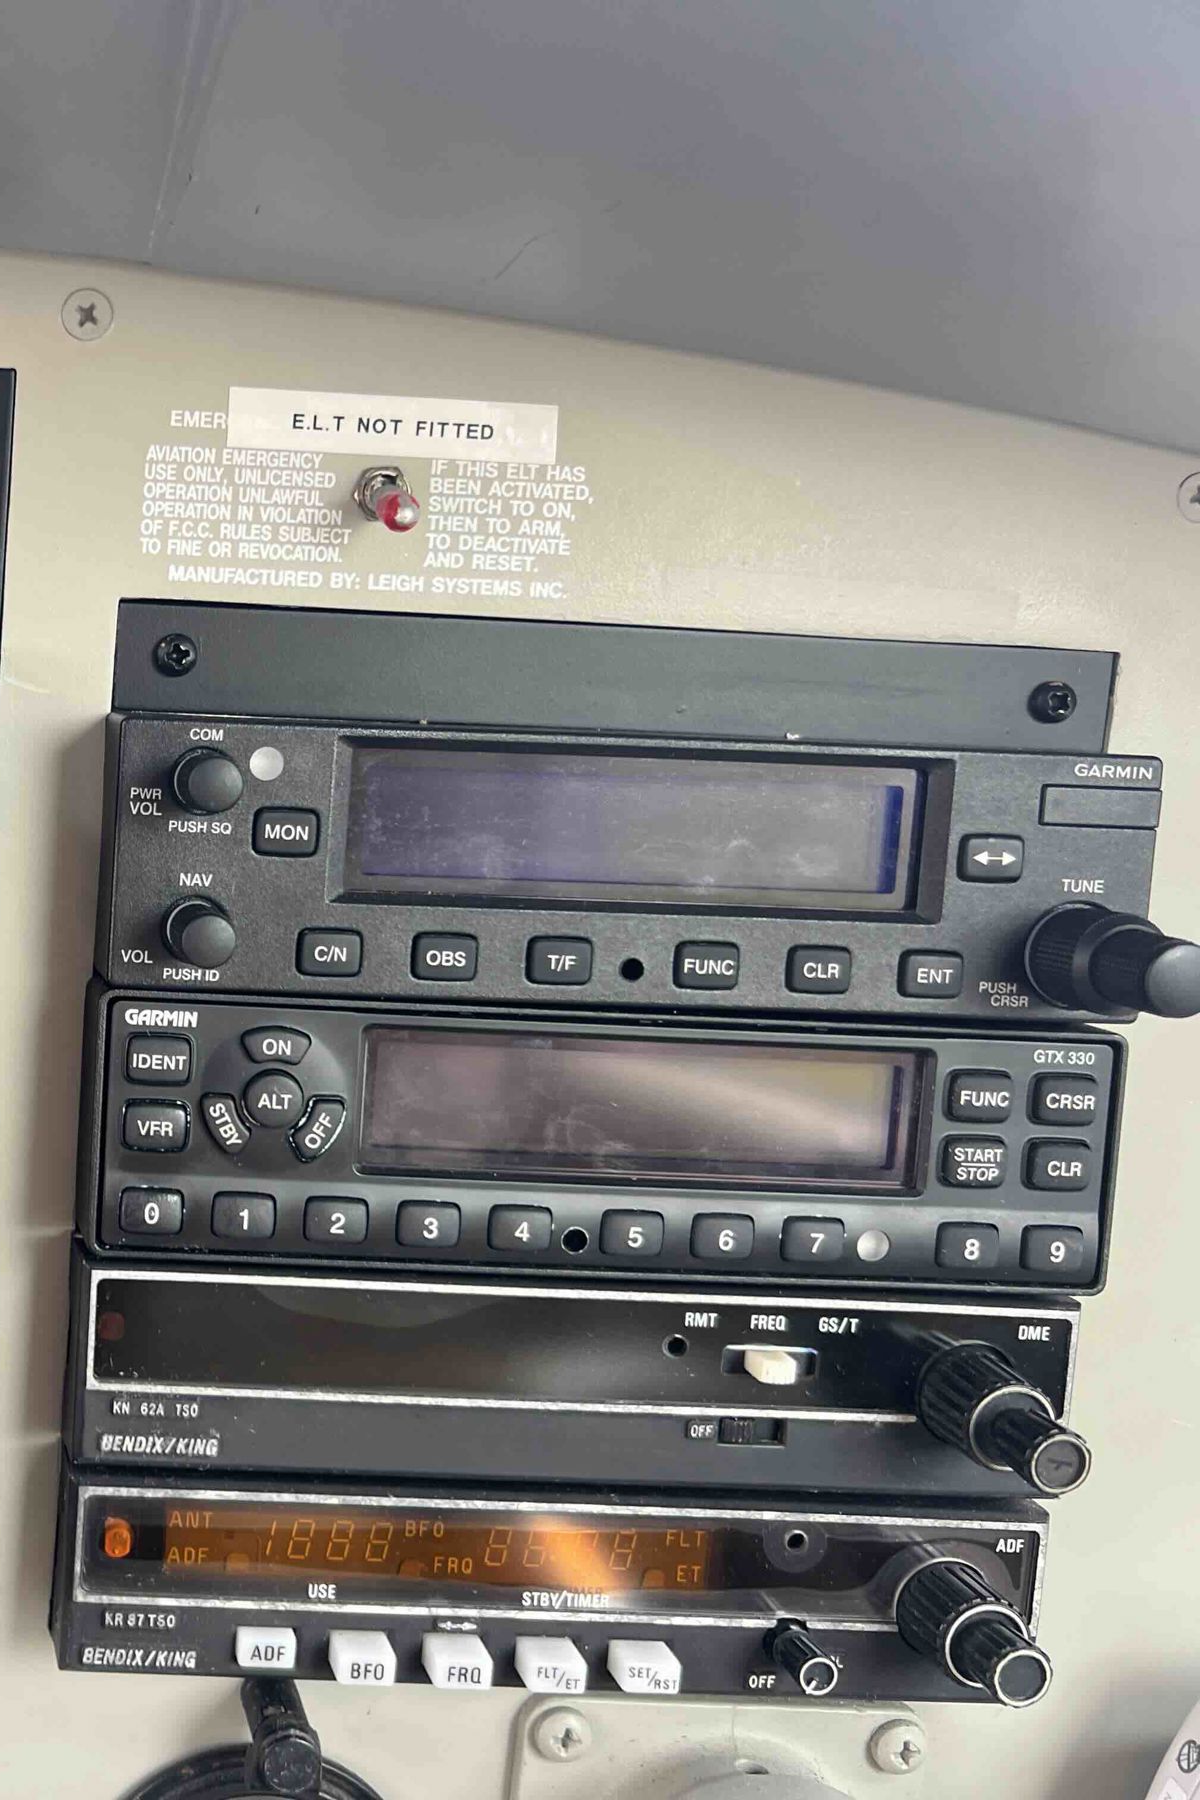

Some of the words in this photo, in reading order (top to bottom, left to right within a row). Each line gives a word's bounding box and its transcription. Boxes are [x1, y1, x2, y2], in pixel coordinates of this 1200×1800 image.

[293, 414, 345, 432] E.L.T
[358, 418, 401, 435] NOT
[416, 421, 494, 440] FITTED
[147, 445, 216, 463] AVIATION
[222, 449, 323, 468] EMERGENCY
[145, 465, 179, 480] USE
[184, 466, 227, 484] ONLY,
[234, 470, 336, 488] UNLICENSED
[432, 460, 448, 475] IF
[453, 461, 498, 477] THIS
[506, 464, 540, 479] ELT
[547, 466, 585, 482] HAS
[144, 483, 232, 501] OPERATION
[239, 487, 324, 506] UNLAWFUL
[430, 479, 483, 496] BEEN
[490, 481, 593, 503] ACTIVATED,
[143, 502, 231, 519] OPERATION
[237, 506, 254, 520] IN
[260, 507, 341, 525] VIOLATION
[429, 497, 500, 515] SWITCH
[512, 500, 534, 516] TO
[543, 502, 576, 522] ON,
[141, 520, 162, 535] OF
[168, 522, 214, 538] F.C.C.
[221, 523, 272, 541] RULES
[279, 527, 351, 545] SUBJECT
[429, 516, 478, 532] THEN
[486, 518, 511, 534] TO
[518, 520, 565, 538] ARM,
[141, 538, 161, 554] TO
[168, 540, 203, 556] FINE
[209, 542, 232, 557] OR
[238, 543, 343, 562] REVOCATION.
[427, 534, 449, 550] TO
[459, 536, 570, 555] DEACTIVATE
[424, 552, 466, 569] AND
[473, 554, 538, 572] RESET.
[168, 565, 322, 588] MANUFACTURED
[331, 572, 360, 589] BY:
[368, 574, 424, 593] LEIGH
[432, 577, 522, 597] SYSTEMS
[531, 581, 566, 598] INC.
[190, 729, 223, 741] COM
[1074, 764, 1153, 779] GARMIN
[131, 788, 162, 799] PWR
[130, 802, 162, 816] VOL
[169, 821, 207, 835] PUSH
[212, 822, 231, 836] SQ
[265, 825, 308, 841] MON
[179, 873, 212, 887] NAV
[1062, 879, 1104, 894] TUNE
[121, 950, 152, 965] VOL
[314, 946, 347, 963] C/N
[426, 950, 466, 967] OBS
[548, 955, 575, 971] T/F
[684, 959, 734, 975] FUNC
[163, 968, 200, 980] PUSH
[207, 970, 219, 981] ID
[804, 963, 839, 980] CLR
[918, 967, 952, 983] ENT
[979, 982, 1016, 995] PUSH
[991, 995, 1028, 1007] CRSR
[125, 1009, 197, 1027] GARMIN
[263, 1039, 291, 1055] ON
[133, 1054, 186, 1070] IDENT
[1034, 1050, 1064, 1064] GTX
[1068, 1051, 1095, 1065] 330
[258, 1094, 292, 1110] ALT
[960, 1091, 1009, 1108] FUNC
[1047, 1094, 1095, 1110] CRSR
[137, 1121, 172, 1137] VFR
[954, 1148, 1002, 1163] START
[957, 1167, 998, 1180] STOP
[1047, 1162, 1081, 1177] CLR
[685, 1312, 717, 1327] RMT
[750, 1315, 785, 1330] FREQ
[819, 1318, 859, 1333] GS/T
[1018, 1326, 1050, 1341] DME
[113, 1402, 129, 1415] KN
[141, 1403, 164, 1416] 62A
[175, 1403, 198, 1417] TSO
[997, 1539, 1024, 1552] ADF
[309, 1584, 336, 1599] USE
[522, 1591, 609, 1608] STBY/TIMER
[251, 1645, 286, 1661] ADF
[351, 1664, 385, 1680] BFO
[448, 1667, 482, 1684] FRQ
[749, 1675, 775, 1688] OFF
